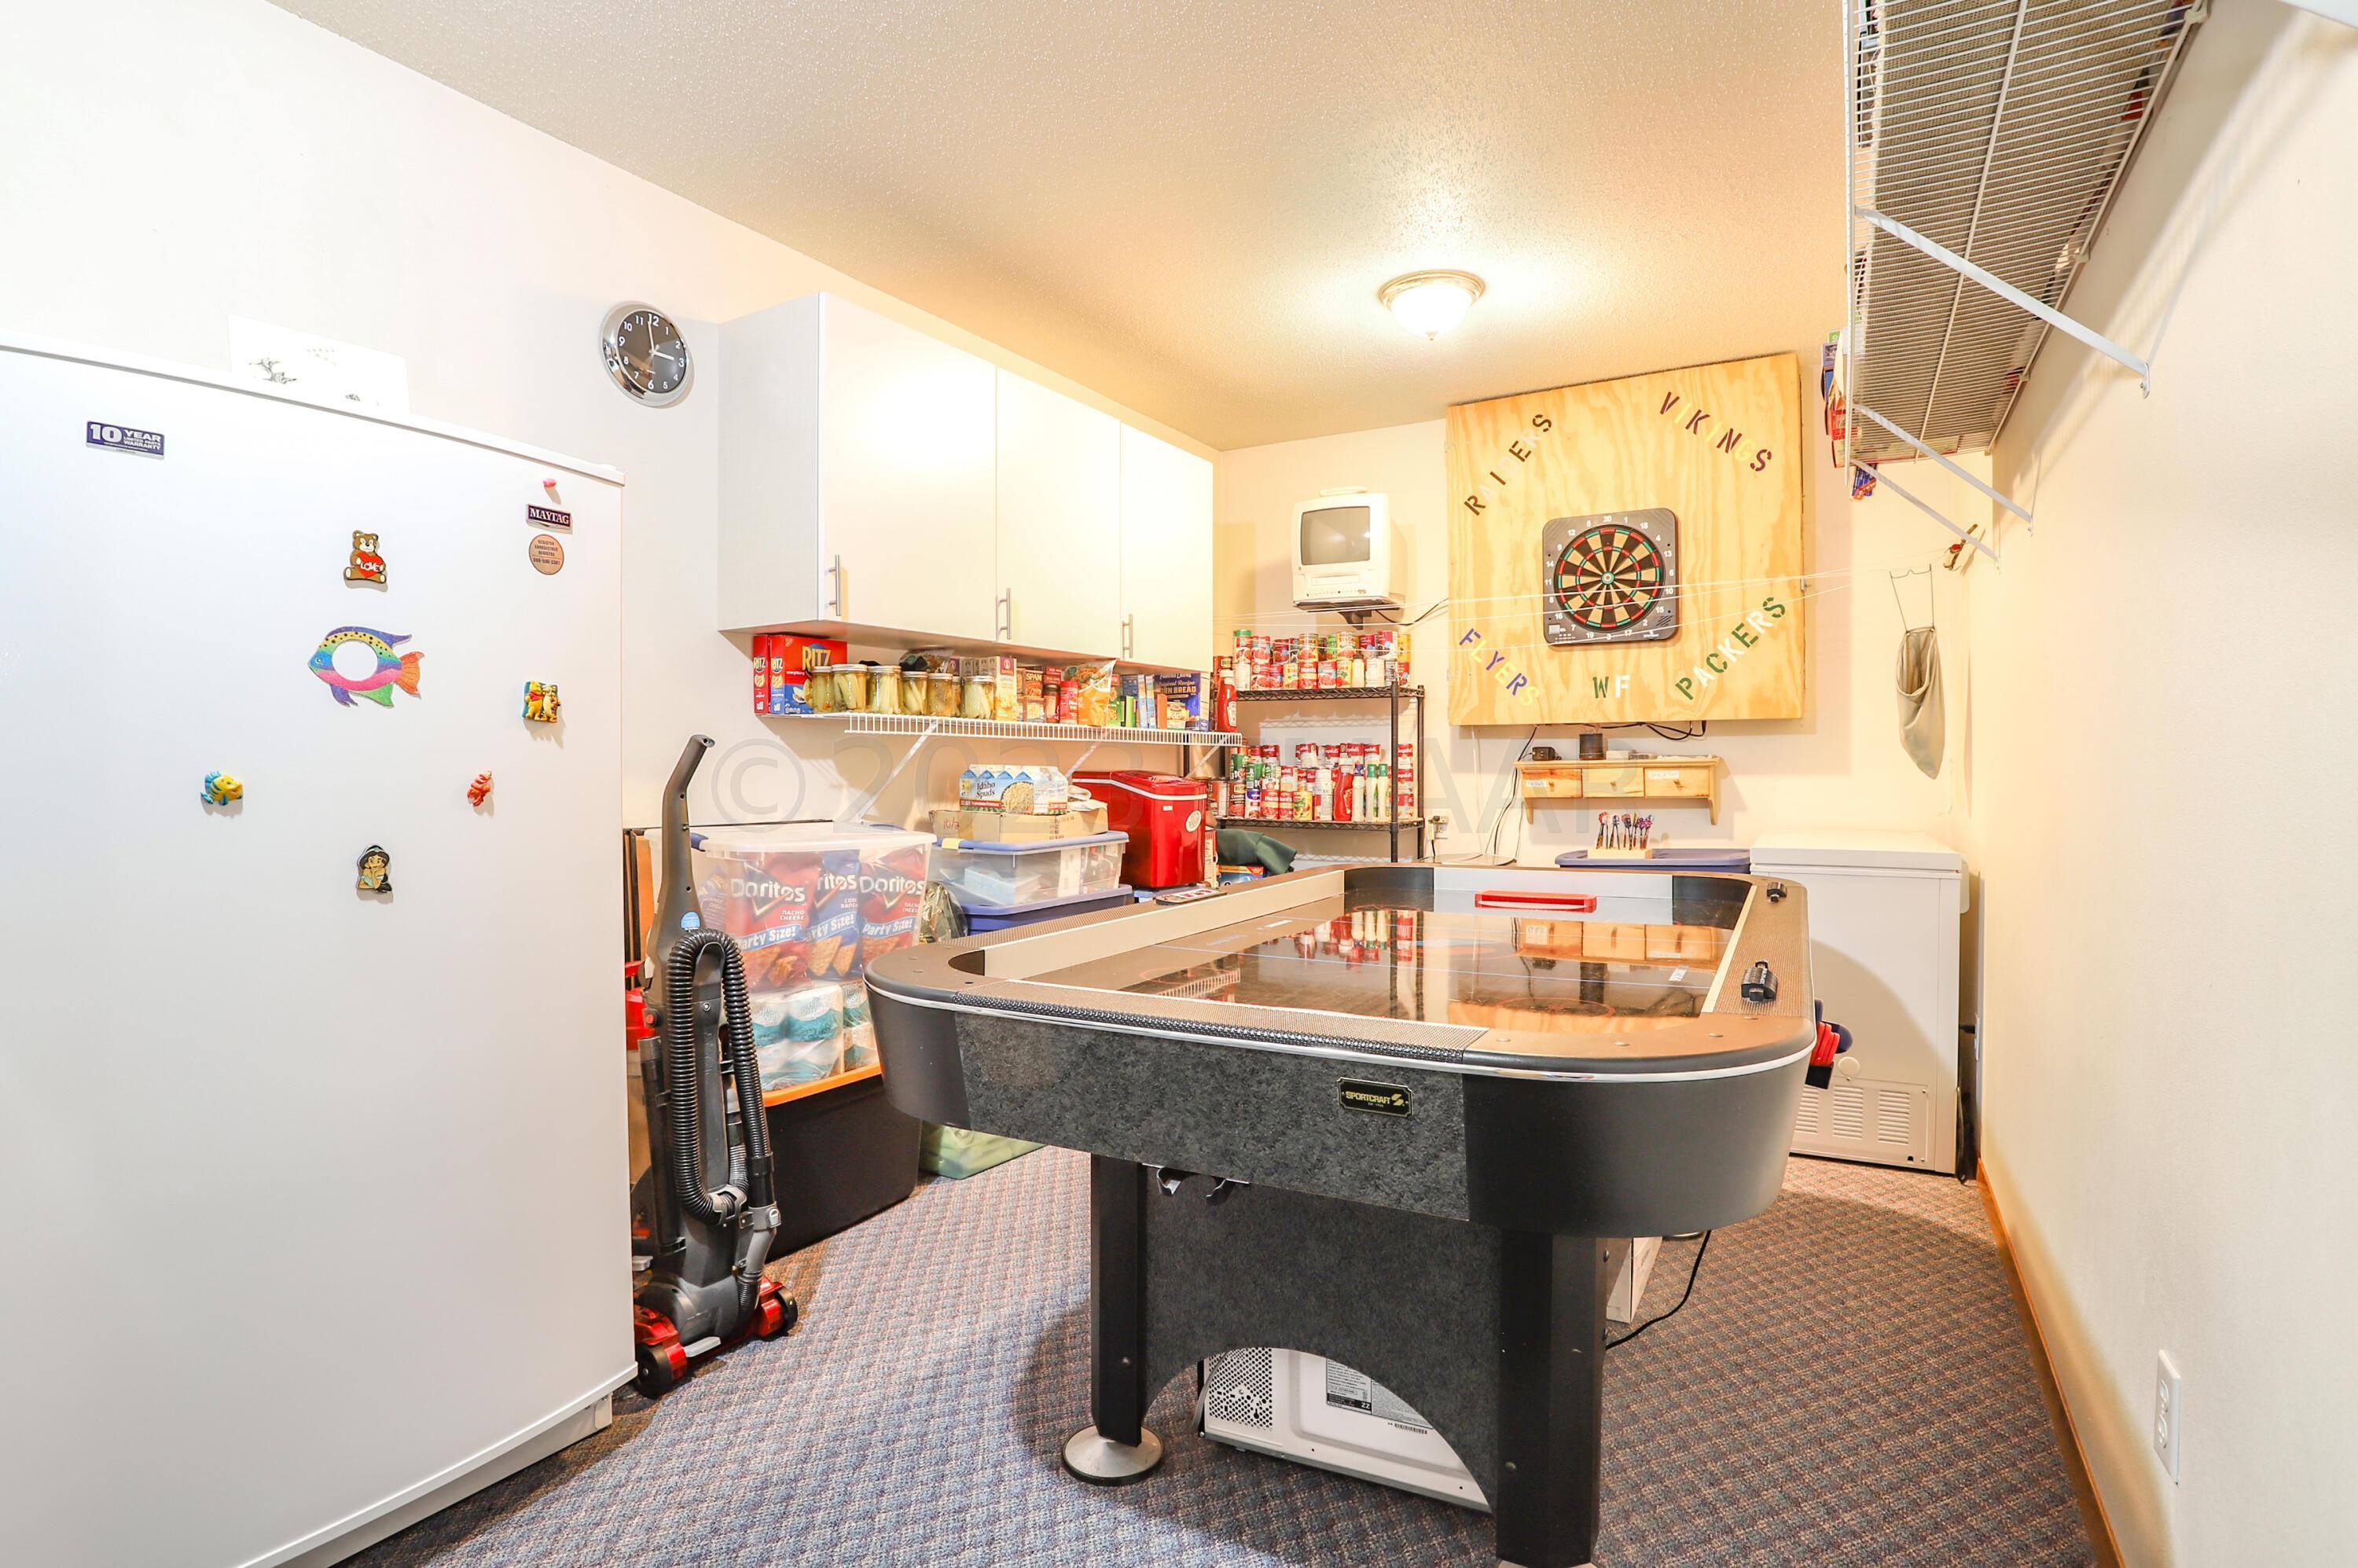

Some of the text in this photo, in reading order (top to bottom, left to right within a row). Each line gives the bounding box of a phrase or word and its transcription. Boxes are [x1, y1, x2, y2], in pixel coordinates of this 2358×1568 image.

[624, 321, 633, 332] 10
[635, 315, 644, 326] 11
[666, 326, 669, 335] 1
[619, 336, 626, 347] 9
[623, 356, 629, 365] 8
[678, 358, 685, 368] 3
[648, 380, 654, 390] 6
[90, 424, 161, 443] 10 YEAR
[1659, 391, 1772, 472] VIKINGS
[123, 440, 161, 450] WARRANTY
[530, 507, 569, 524] MAYTAG
[361, 561, 379, 572] LOVE
[1675, 597, 1786, 701] PACKERS
[754, 657, 766, 669] RITZ
[771, 658, 783, 670] RITZ
[802, 645, 831, 673] RITZ
[1459, 628, 1540, 707] FLYERS
[1026, 673, 1042, 681] SPAM
[1173, 685, 1196, 695] BREAD
[977, 781, 995, 791] Idaho
[975, 790, 995, 799] Spuds
[817, 873, 857, 890] ritos
[859, 876, 925, 895] Doritos
[731, 878, 806, 902] Doritos
[831, 913, 854, 929] Size!
[862, 918, 913, 936] Party Size!
[769, 926, 796, 942] Size!
[1345, 1091, 1390, 1104] SPORTCRAFT
